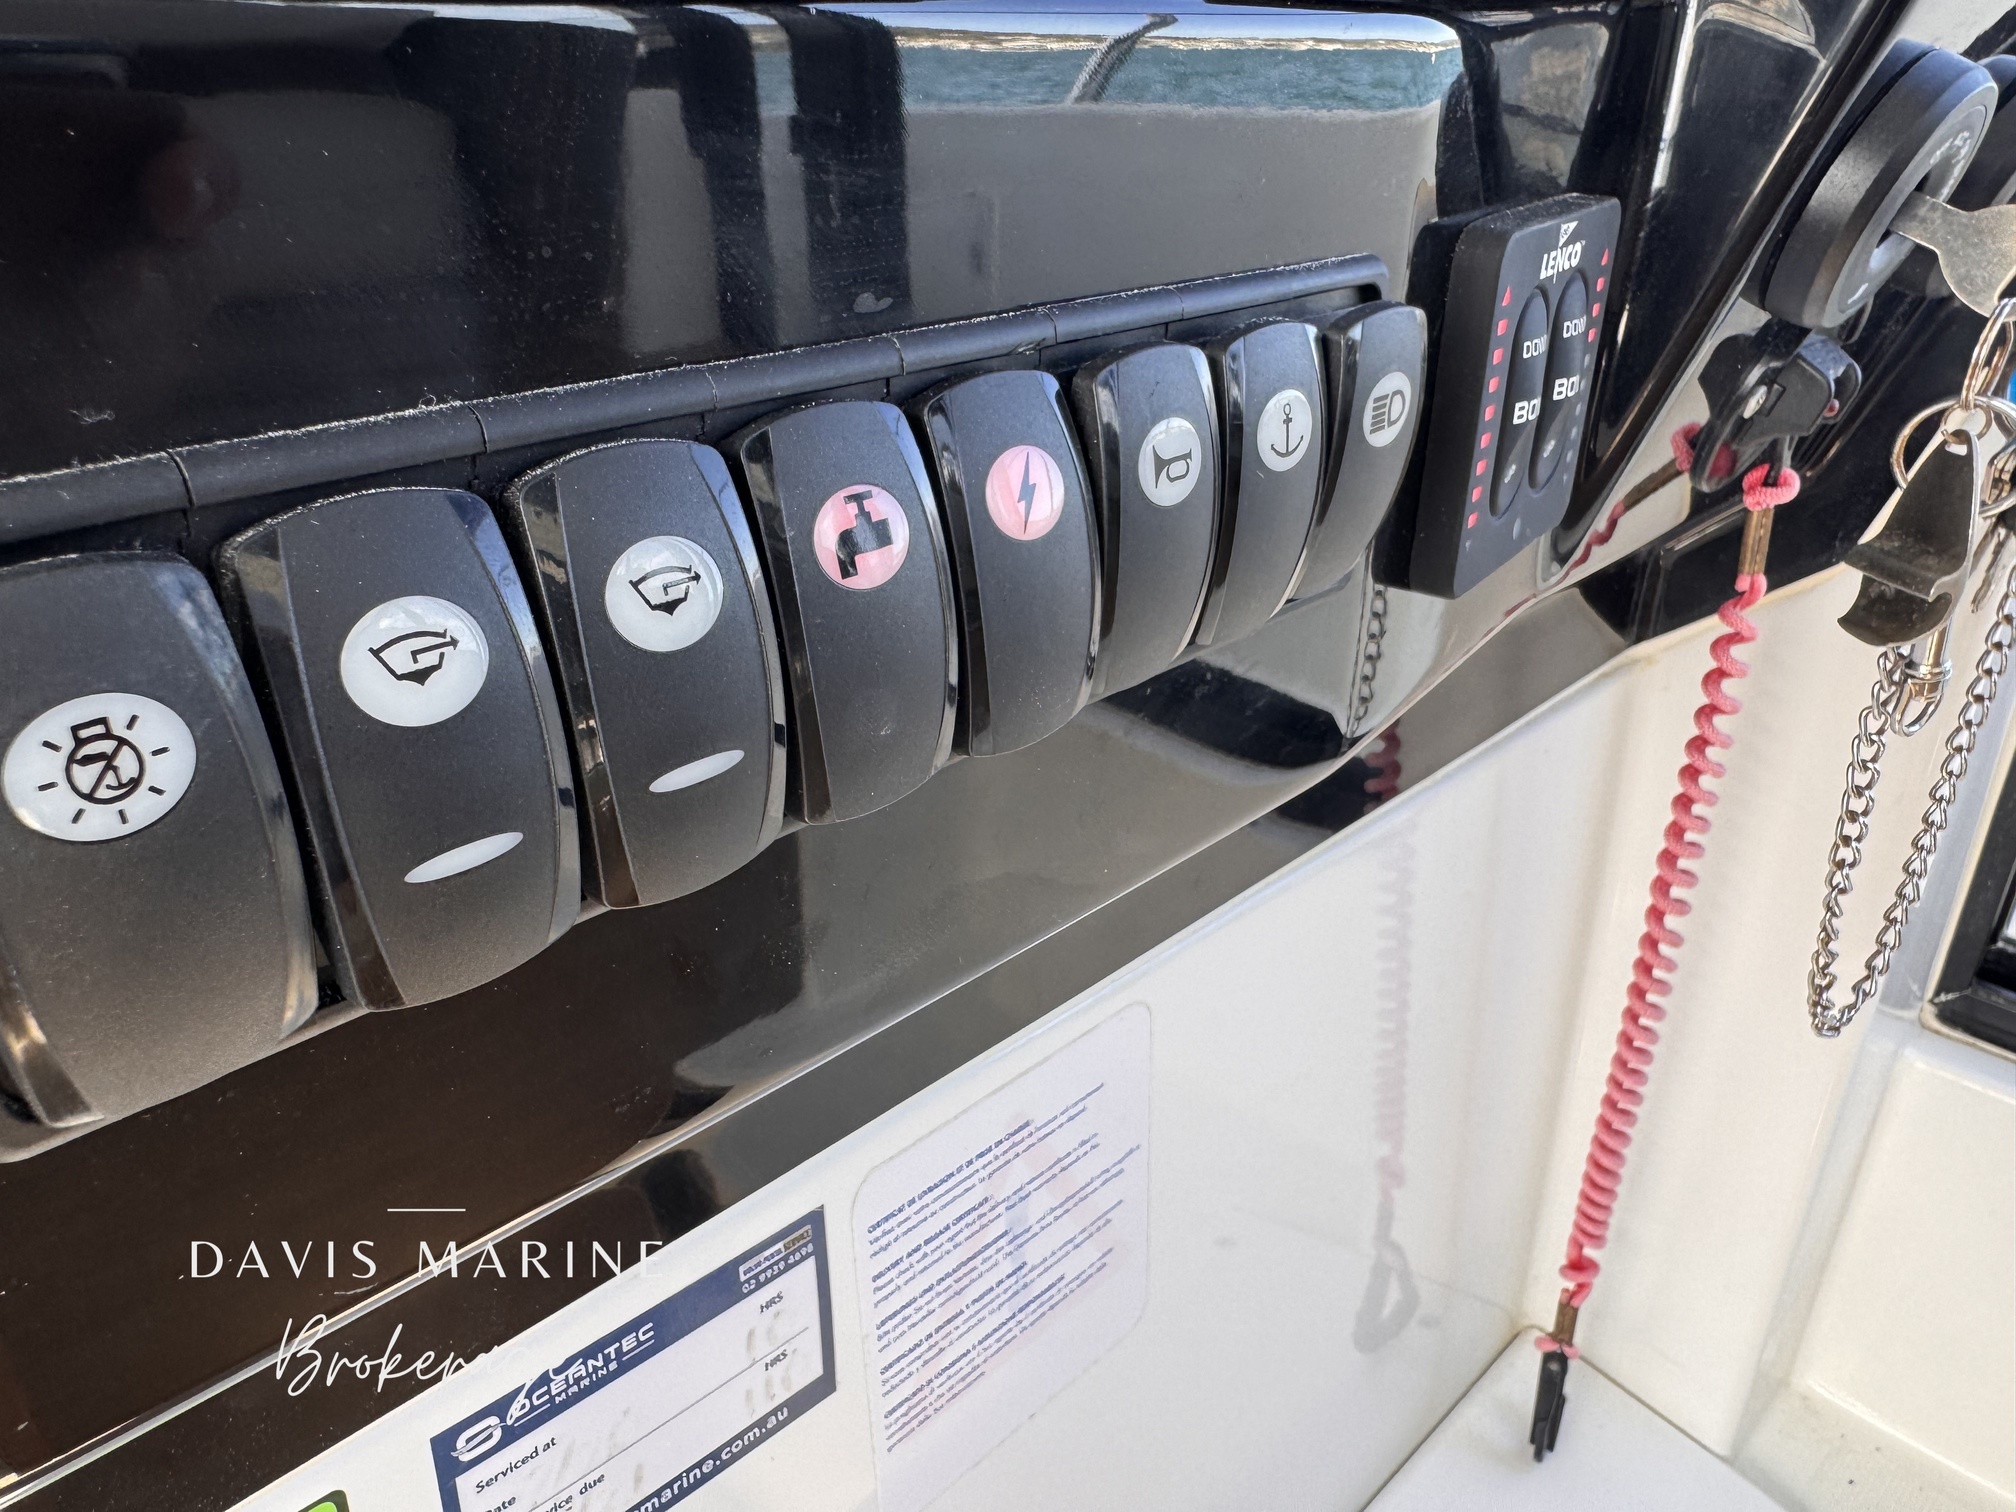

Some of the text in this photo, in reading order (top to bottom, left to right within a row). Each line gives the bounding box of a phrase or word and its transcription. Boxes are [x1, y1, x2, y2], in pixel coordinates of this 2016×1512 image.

[1540, 241, 1582, 280] LENCO
[1563, 315, 1587, 338] DOW
[1523, 334, 1547, 359] DOW
[760, 1290, 783, 1314] HRS
[514, 1322, 655, 1418] OCEANTEC
[555, 1361, 618, 1404] MARINE
[475, 1436, 557, 1494] Serviced at
[634, 1406, 789, 1512] marine.com.au
[579, 1473, 605, 1495] due
